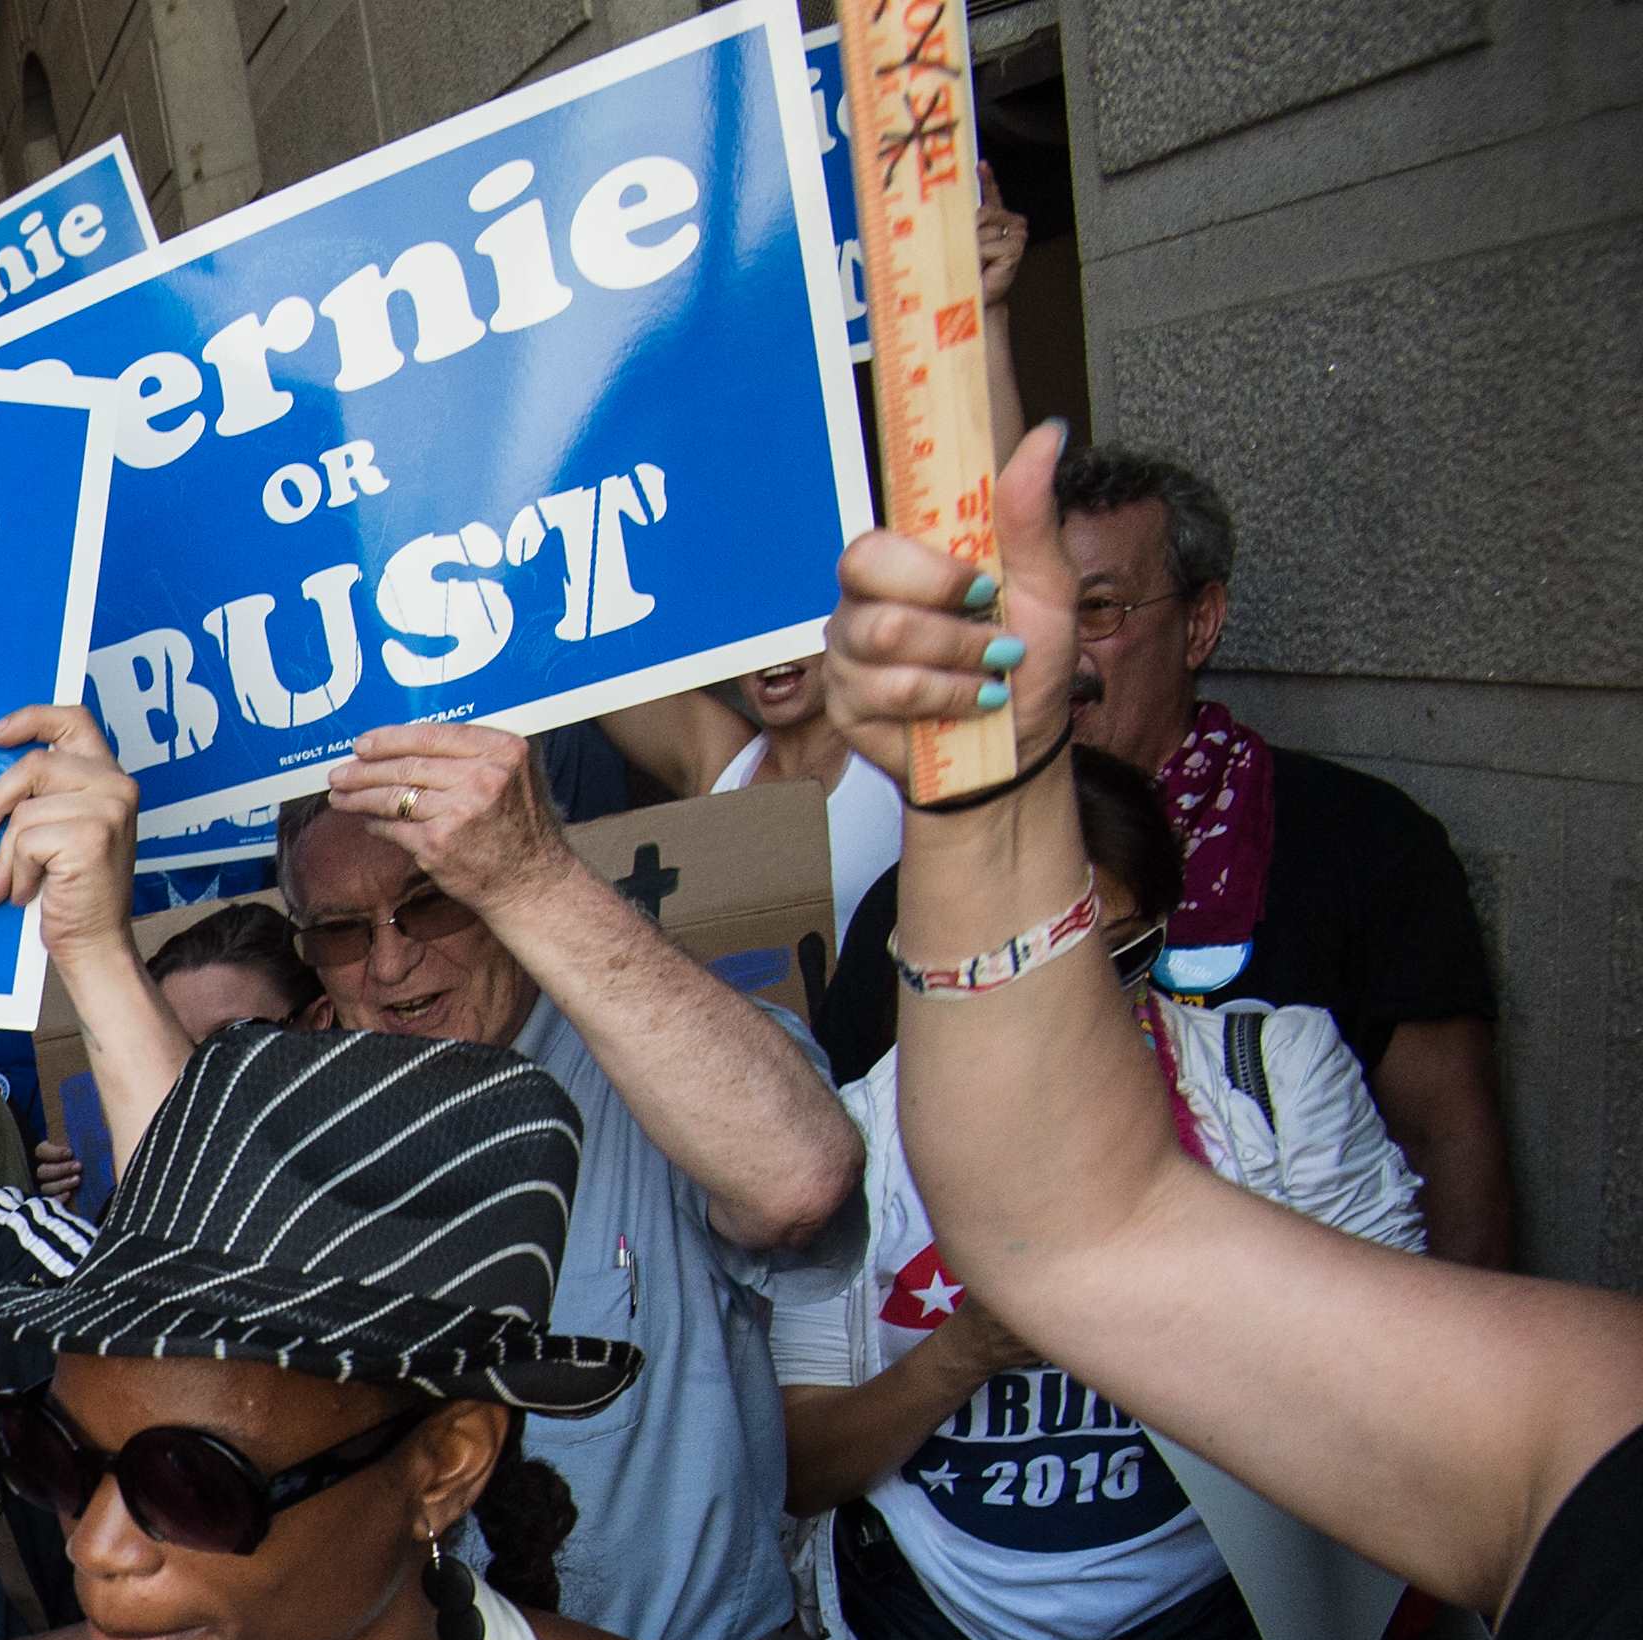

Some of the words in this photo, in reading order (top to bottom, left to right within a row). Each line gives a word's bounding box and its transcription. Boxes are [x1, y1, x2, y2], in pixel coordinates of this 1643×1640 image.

[18, 154, 699, 470] ernie
[262, 438, 389, 524] OR
[86, 461, 668, 774] BUST
[278, 745, 324, 767] REVOLT
[981, 1445, 1145, 1508] 2016
